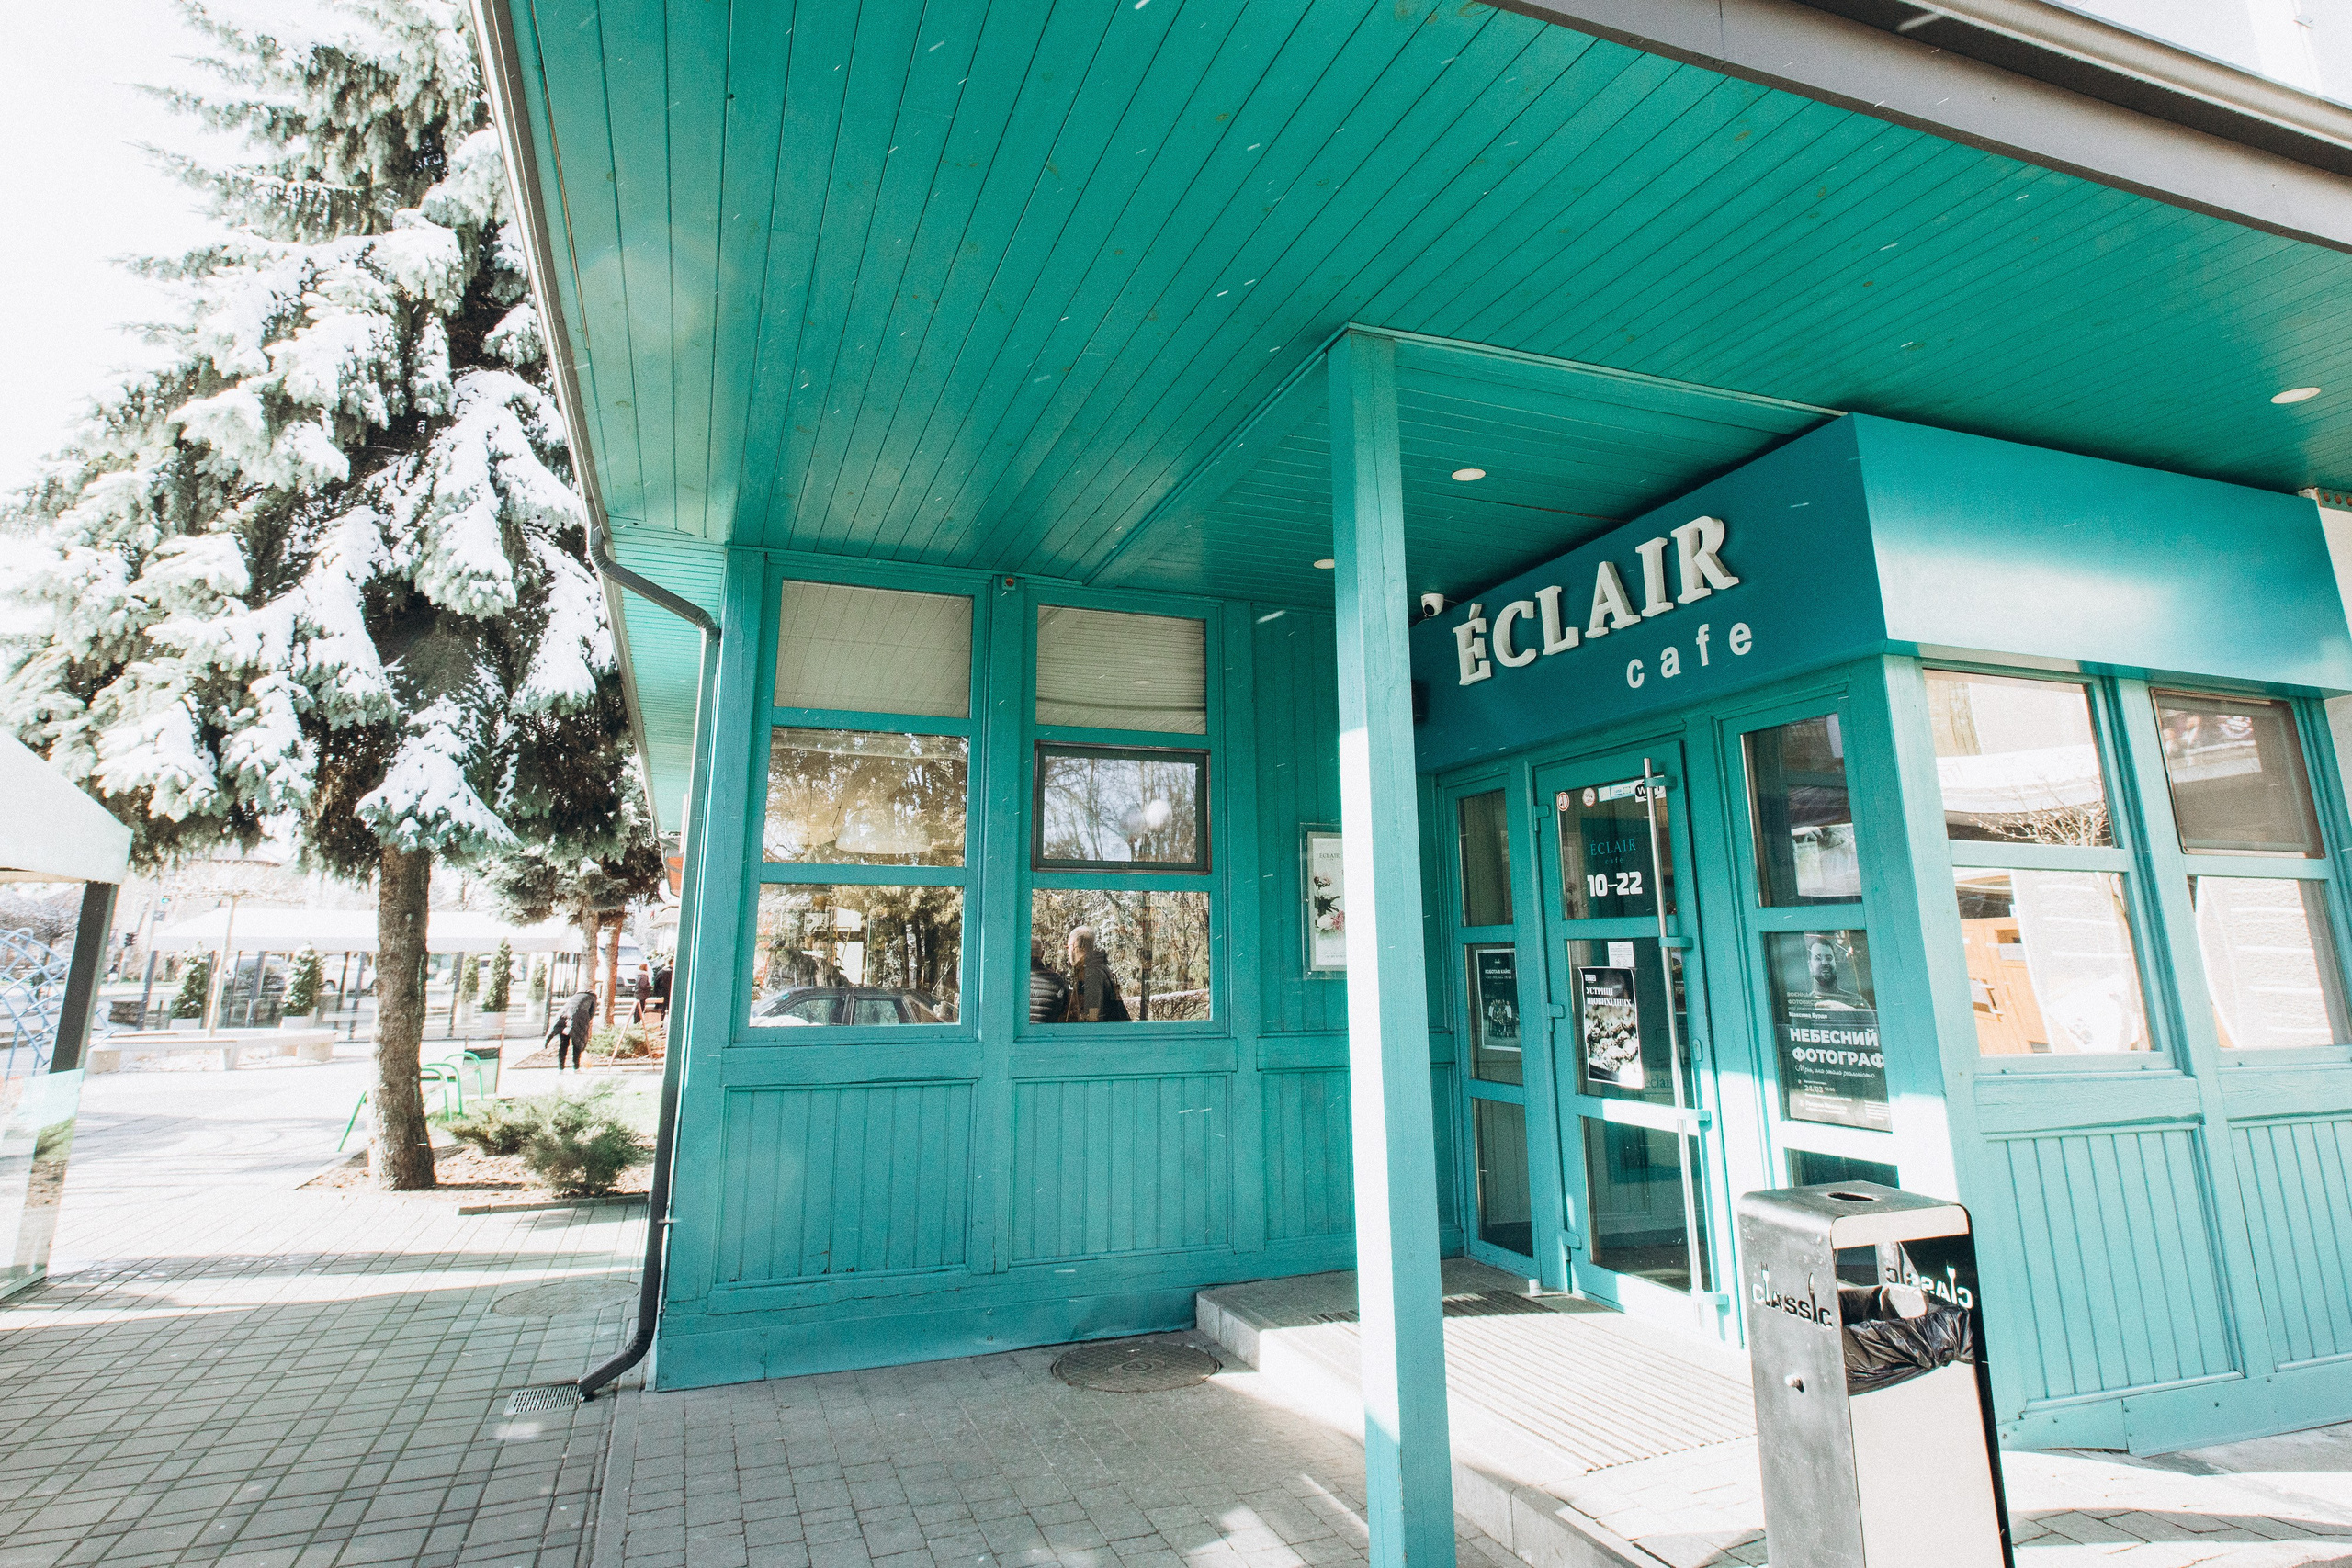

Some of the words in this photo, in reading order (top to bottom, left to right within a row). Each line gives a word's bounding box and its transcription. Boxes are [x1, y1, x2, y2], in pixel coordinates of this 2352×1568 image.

[1453, 514, 1740, 686] ÉCLAIR
[1625, 621, 1753, 689] cafe
[1589, 837, 1637, 856] ÉCLAIR
[1586, 871, 1643, 897] 10-22
[1790, 1027, 1879, 1046] НЕБЕСНИЙ
[1792, 1046, 1885, 1068] ФОТОГРАФ
